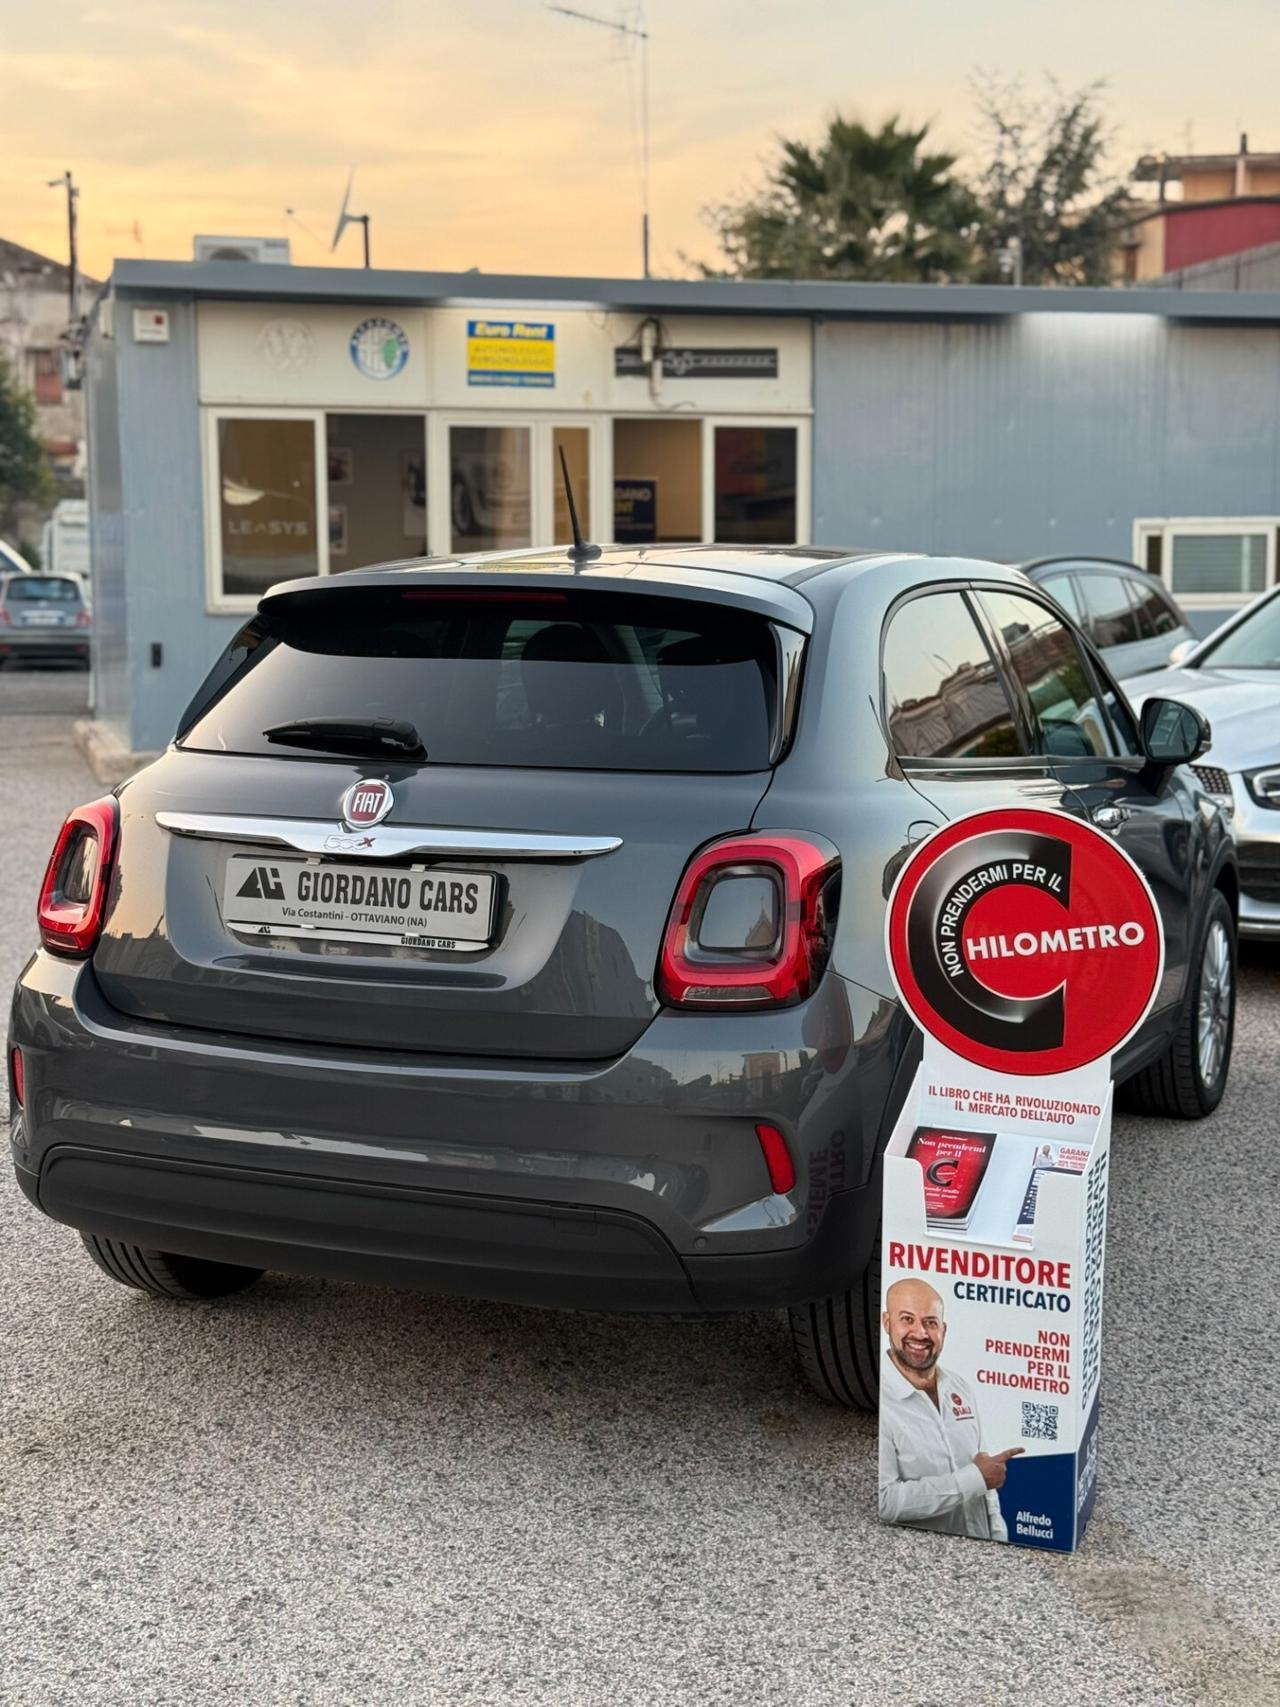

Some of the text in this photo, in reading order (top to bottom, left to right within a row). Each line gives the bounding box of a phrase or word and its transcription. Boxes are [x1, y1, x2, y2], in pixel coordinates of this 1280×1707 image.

[475, 322, 510, 338] Euro
[228, 520, 308, 536] LEASYS
[352, 792, 383, 813] FIAT
[297, 870, 412, 909] GIORDANO
[419, 879, 479, 914] CARS
[282, 907, 296, 916] Via
[298, 908, 344, 920] Costantini
[351, 912, 405, 926] OTTAVIANO
[407, 916, 428, 928] (NA)
[941, 863, 1064, 977] NON PRENDERMI PER IL
[401, 936, 456, 949] GIORDANO CARS
[966, 921, 1145, 961] HILOMETRO
[928, 1085, 1101, 1116] IL LIBRO CHE HA RIVOLUZIONATO
[955, 1100, 1075, 1126] IL MERCATO DELL'AUTO
[917, 1138, 936, 1147] Non
[937, 1142, 986, 1153] prendermi
[936, 1149, 952, 1157] per
[1084, 1168, 1094, 1282] MERCATO
[1096, 1181, 1106, 1270] LIBRO
[889, 1241, 1071, 1289] RIVENDITORE
[1088, 1157, 1101, 1367] RIVOLUZIONATO
[953, 1281, 1071, 1313] CERTIFICATO
[985, 1338, 1070, 1363] PRENDERMI
[1038, 1330, 1070, 1347] NON
[977, 1369, 1070, 1395] CHILOMETRO
[1027, 1360, 1070, 1379] PER IL
[1016, 1511, 1052, 1526] Alfredo
[1016, 1523, 1054, 1539] Bellucci
